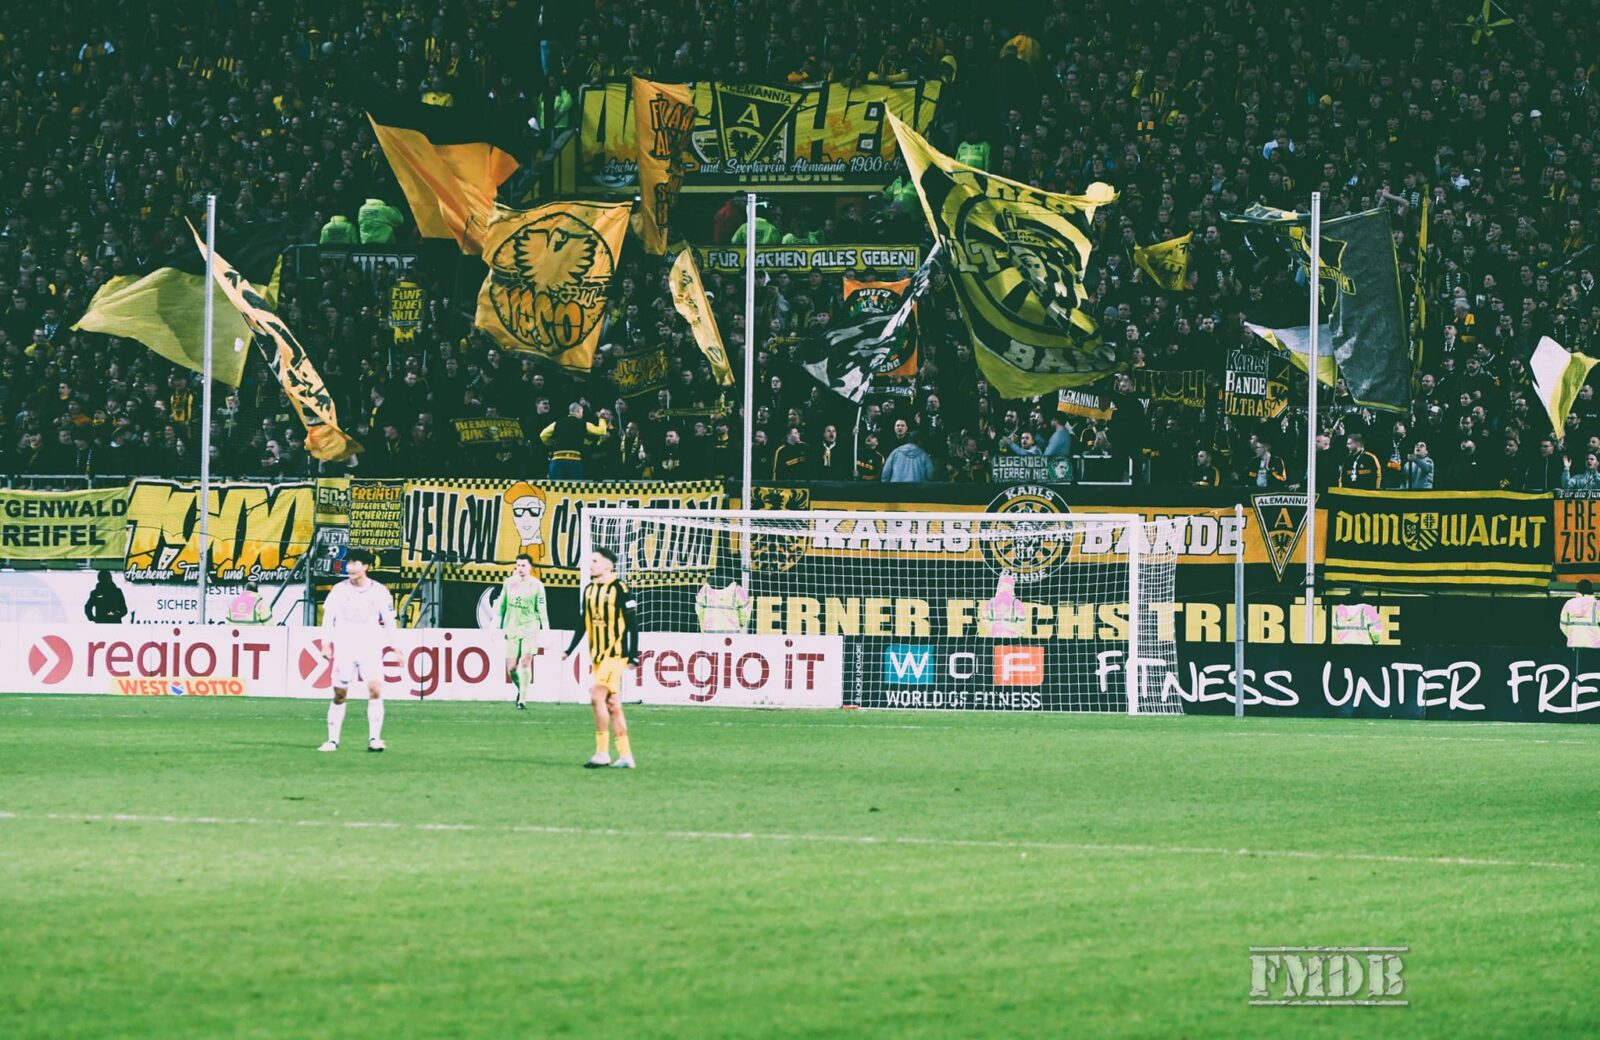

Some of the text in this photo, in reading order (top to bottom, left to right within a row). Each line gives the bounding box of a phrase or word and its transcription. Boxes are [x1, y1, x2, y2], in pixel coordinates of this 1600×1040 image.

[737, 103, 761, 128] A
[850, 155, 883, 172] 1900
[708, 249, 915, 268] FÜR ACHEN ALLES GEBEN!
[351, 486, 401, 501] FREIHEIT
[1004, 486, 1055, 500] KARLS
[0, 499, 128, 518] GENWALD
[1274, 507, 1294, 529] A
[402, 489, 502, 564] YELLOW
[811, 508, 973, 553] KARLS
[1335, 510, 1547, 549] DOM WACHT
[1561, 532, 1600, 562] ZUS
[125, 563, 174, 580] Aachener
[223, 565, 243, 580] und
[157, 599, 198, 610] SICHER
[750, 595, 1402, 646] ERNER FCHS TRIBÜE
[372, 632, 491, 697] egio
[635, 637, 770, 703] regio
[117, 679, 244, 696] WEST LOTTO
[1094, 650, 1300, 707] FTNESS
[1322, 660, 1486, 711] UNTER
[885, 690, 1042, 709] WORLD OF FITNESS
